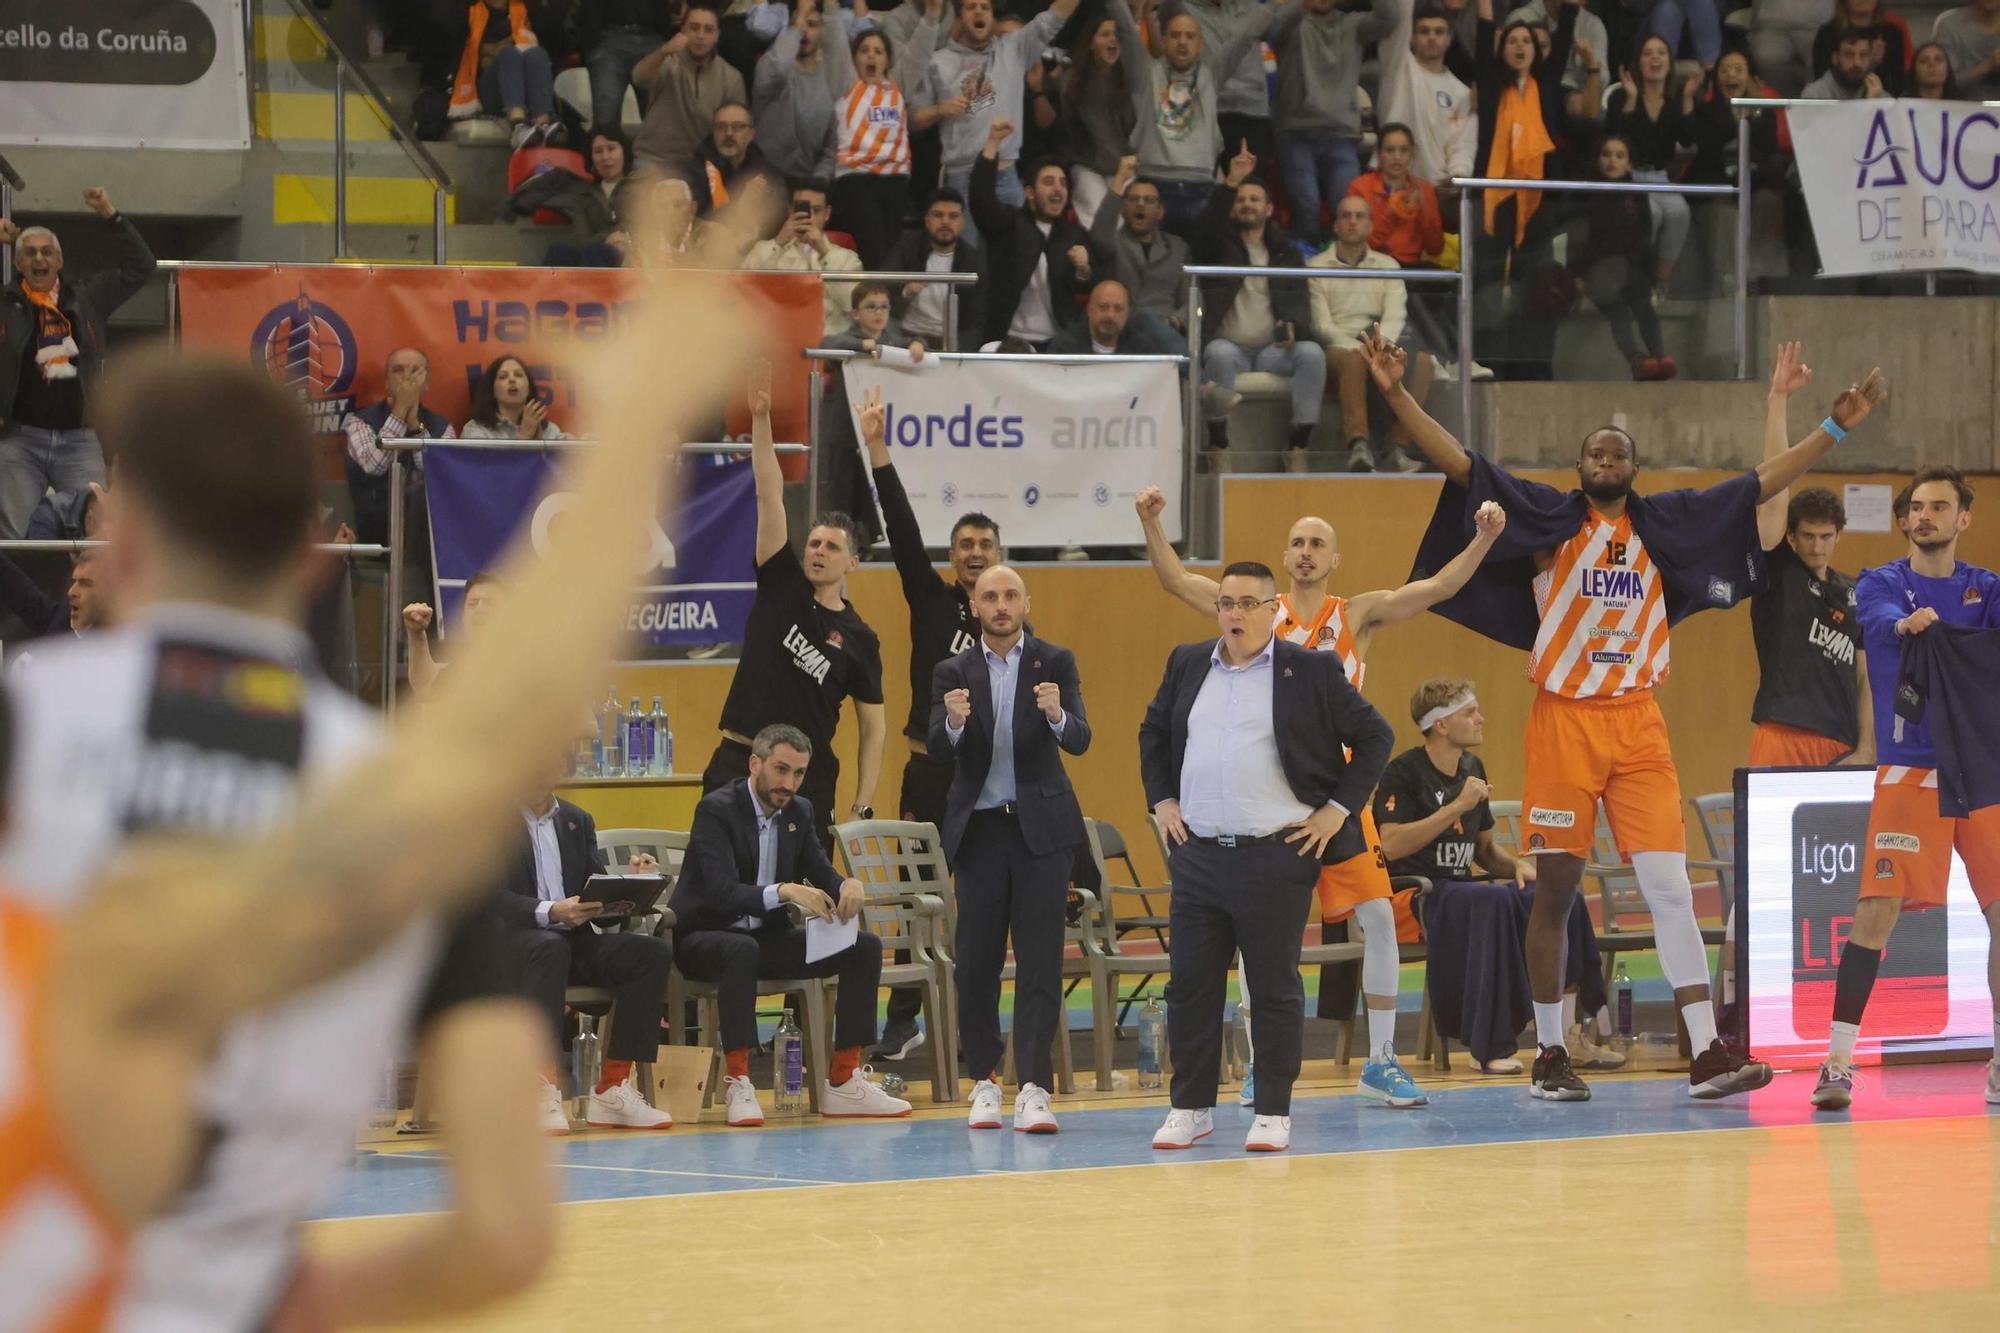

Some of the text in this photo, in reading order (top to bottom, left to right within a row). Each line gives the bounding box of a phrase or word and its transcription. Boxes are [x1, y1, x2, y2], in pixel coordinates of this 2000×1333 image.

[59, 25, 89, 49] da
[97, 28, 188, 52] Coruña
[1857, 197, 1903, 242] DE
[1049, 396, 1158, 449] ancín
[1605, 540, 1627, 566] 12
[1582, 568, 1644, 600] LEYMA
[1603, 600, 1629, 609] NATURA
[782, 623, 832, 686] LEYMA
[1808, 617, 1855, 666] LEYMA
[1802, 834, 1856, 884] Liga
